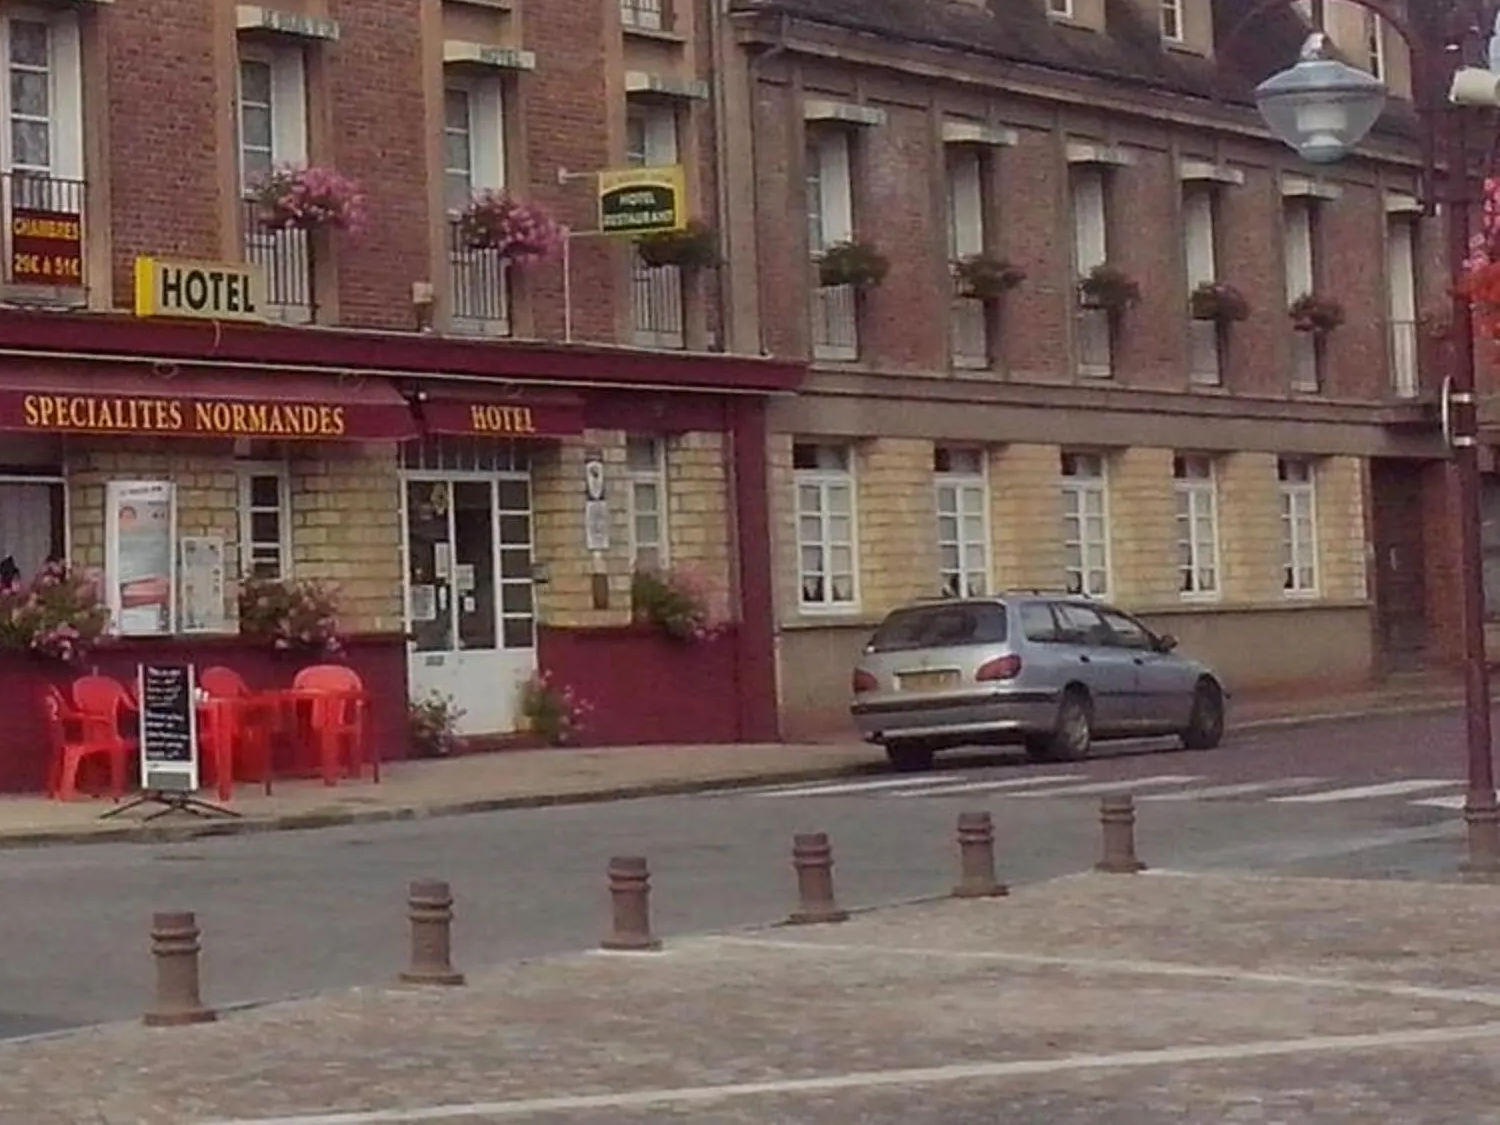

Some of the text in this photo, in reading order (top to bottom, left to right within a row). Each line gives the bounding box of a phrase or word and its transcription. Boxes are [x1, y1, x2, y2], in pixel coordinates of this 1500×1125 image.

[161, 267, 254, 313] HOTEL
[23, 394, 345, 435] SPECIALITES NORMANDES
[470, 403, 536, 434] HOTEL
